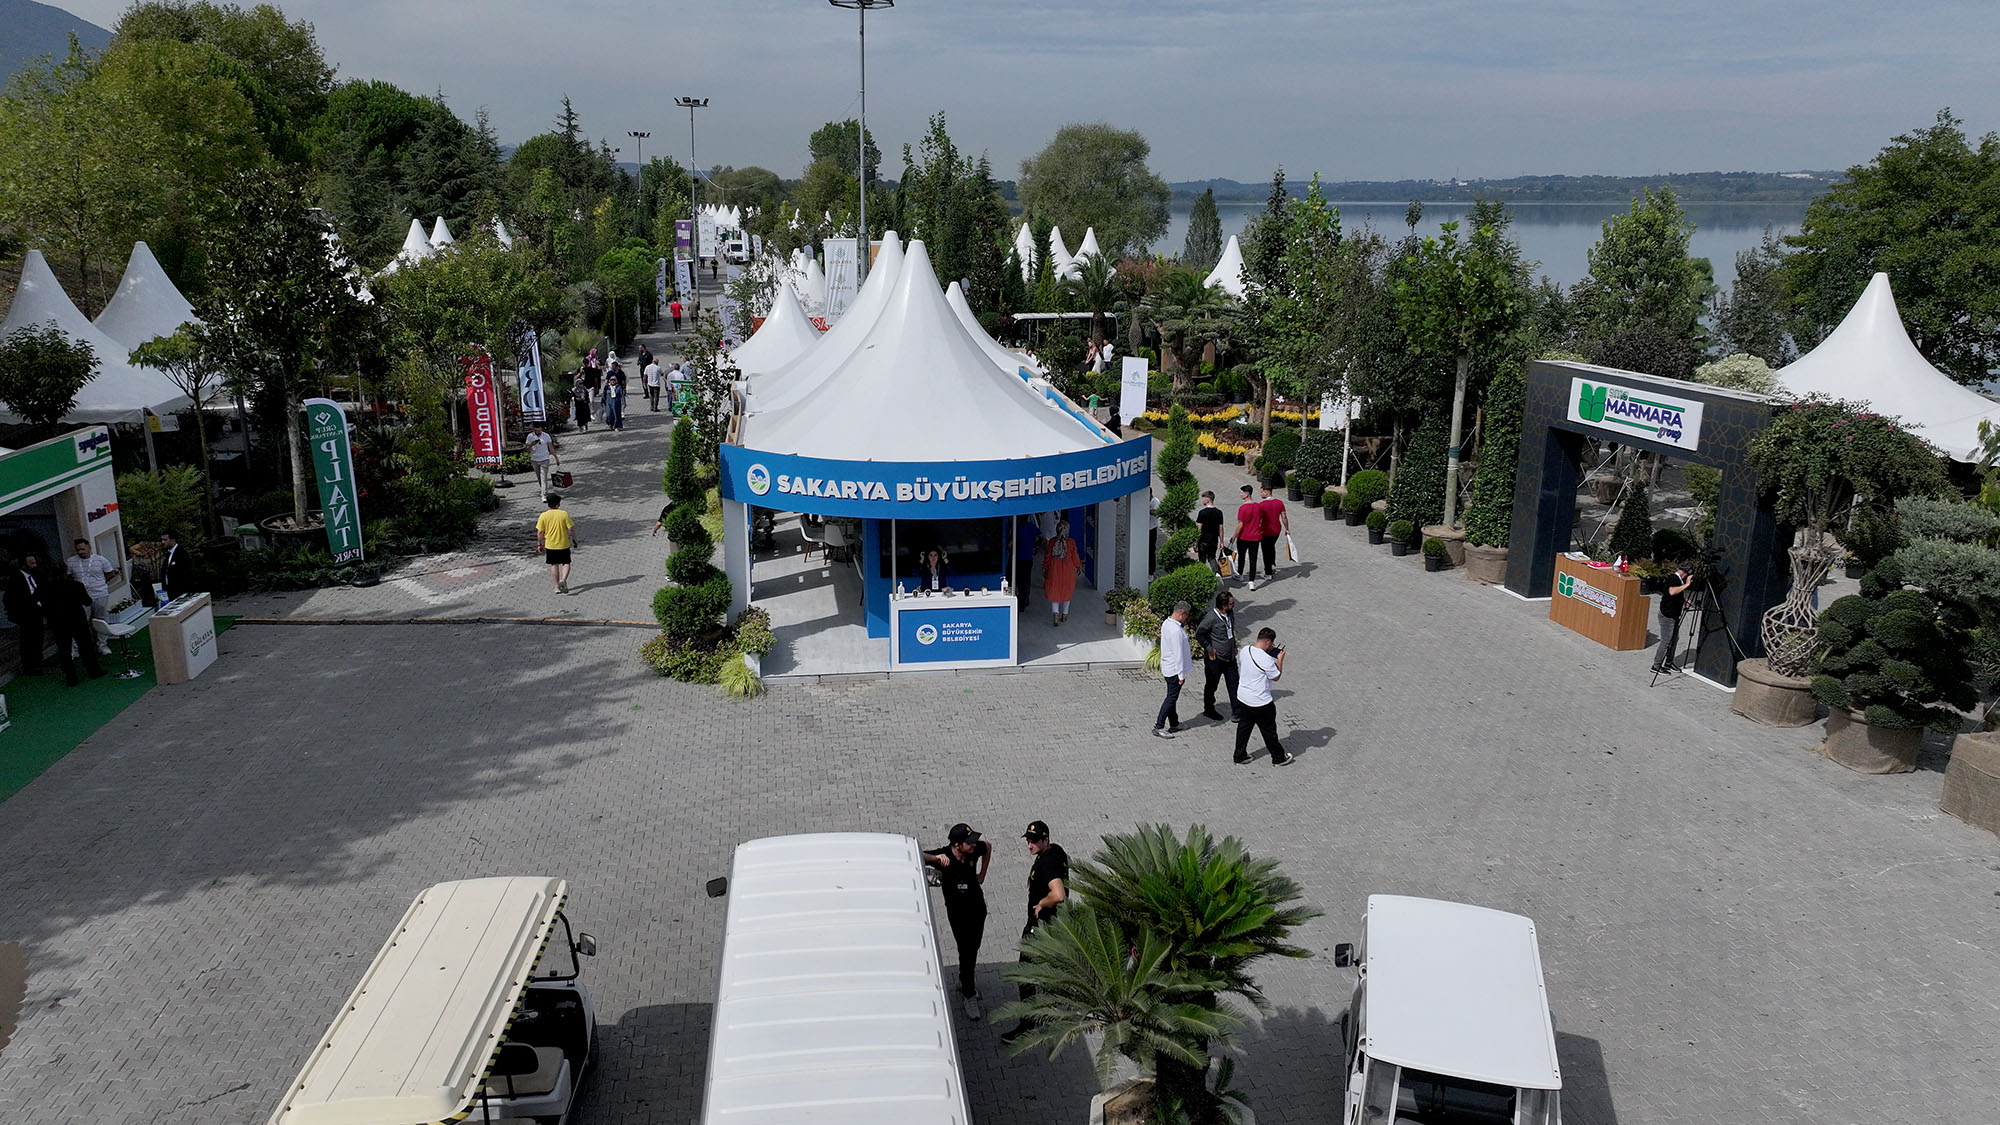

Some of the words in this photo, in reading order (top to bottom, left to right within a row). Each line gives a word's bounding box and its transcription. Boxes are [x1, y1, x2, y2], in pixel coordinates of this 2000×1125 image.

[1606, 398, 1683, 428] MARMARA
[1657, 427, 1682, 442] group
[777, 475, 890, 501] SAKARYA
[896, 472, 1056, 502] BÜYÜKŞEHİR
[1060, 451, 1148, 491] BELEDİYESİ
